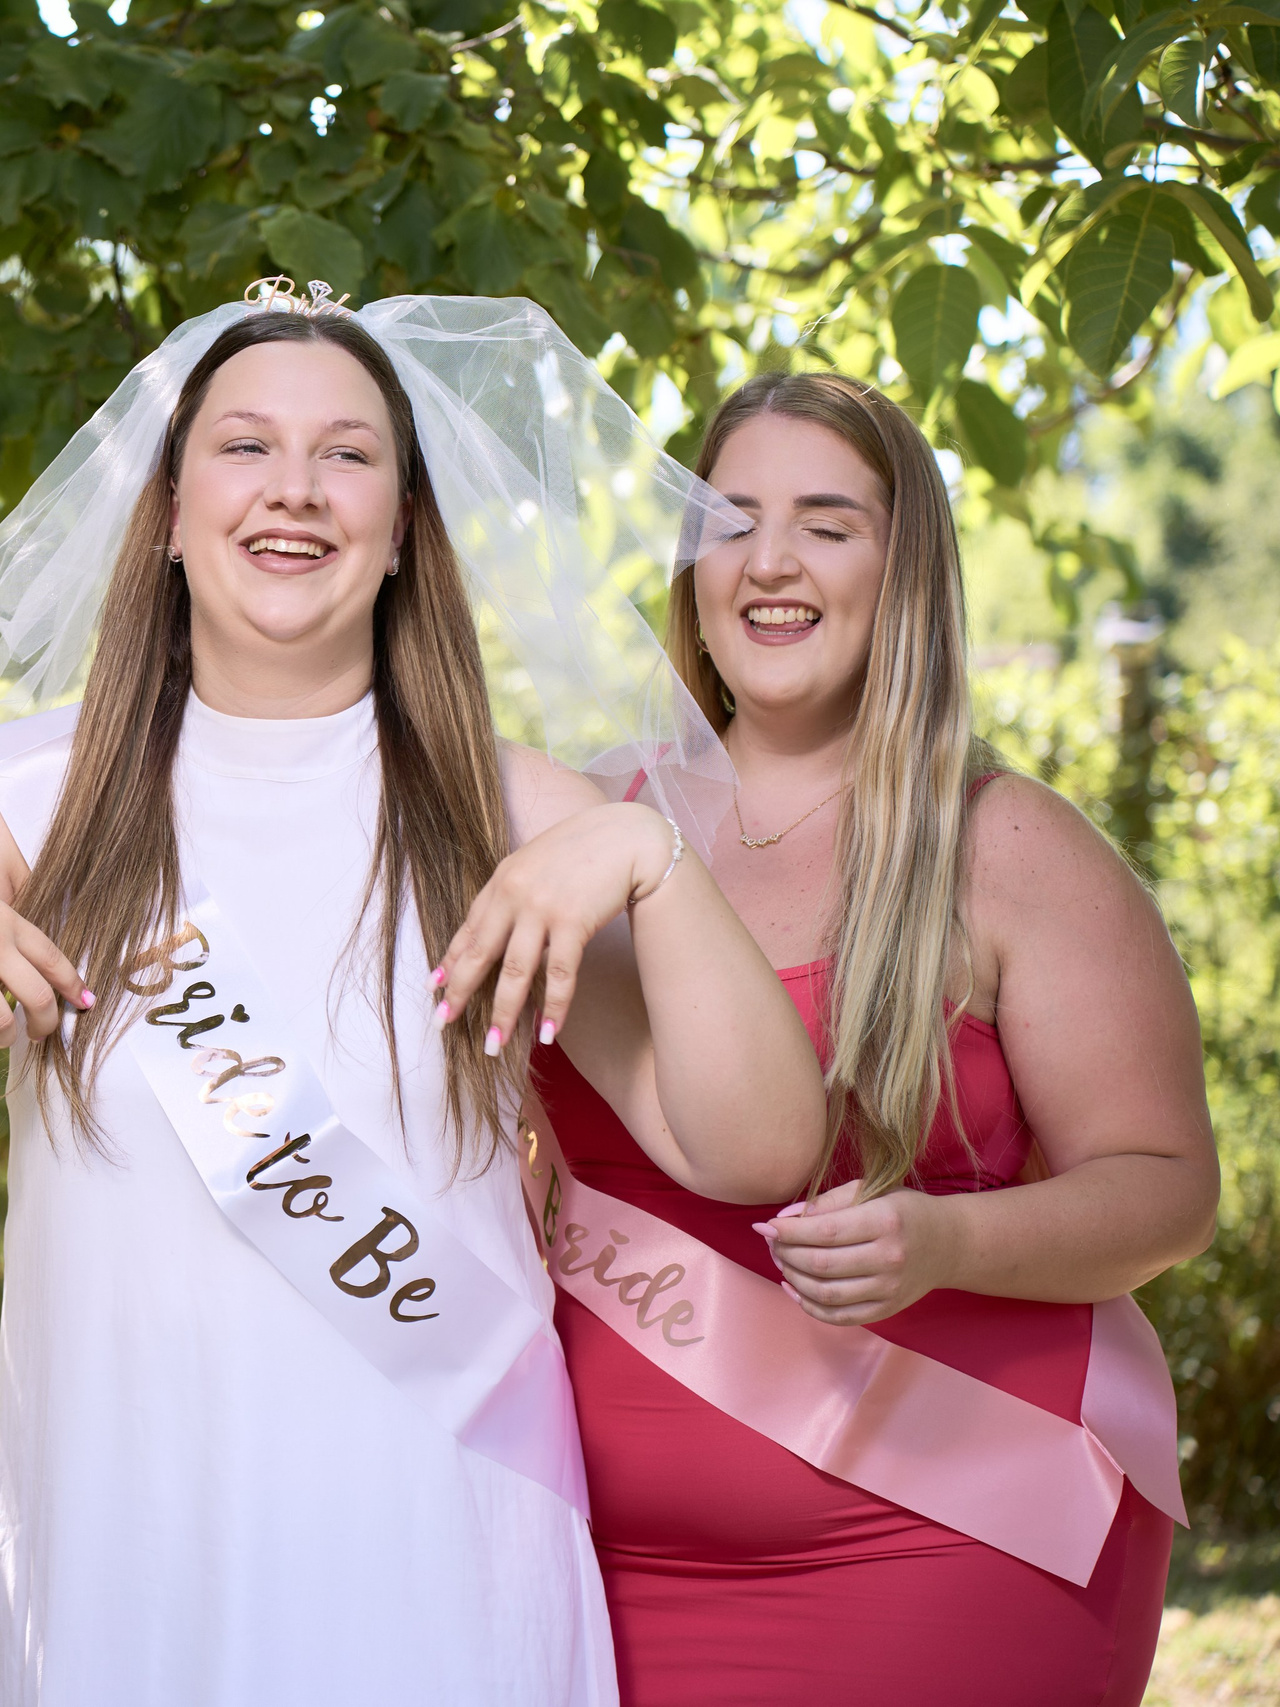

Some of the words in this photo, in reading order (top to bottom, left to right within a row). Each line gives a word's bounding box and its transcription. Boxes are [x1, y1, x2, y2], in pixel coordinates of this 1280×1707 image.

[124, 920, 286, 1138] Bride
[246, 1132, 345, 1222] to
[329, 1206, 440, 1323] Be
[543, 1162, 705, 1348] Bride
